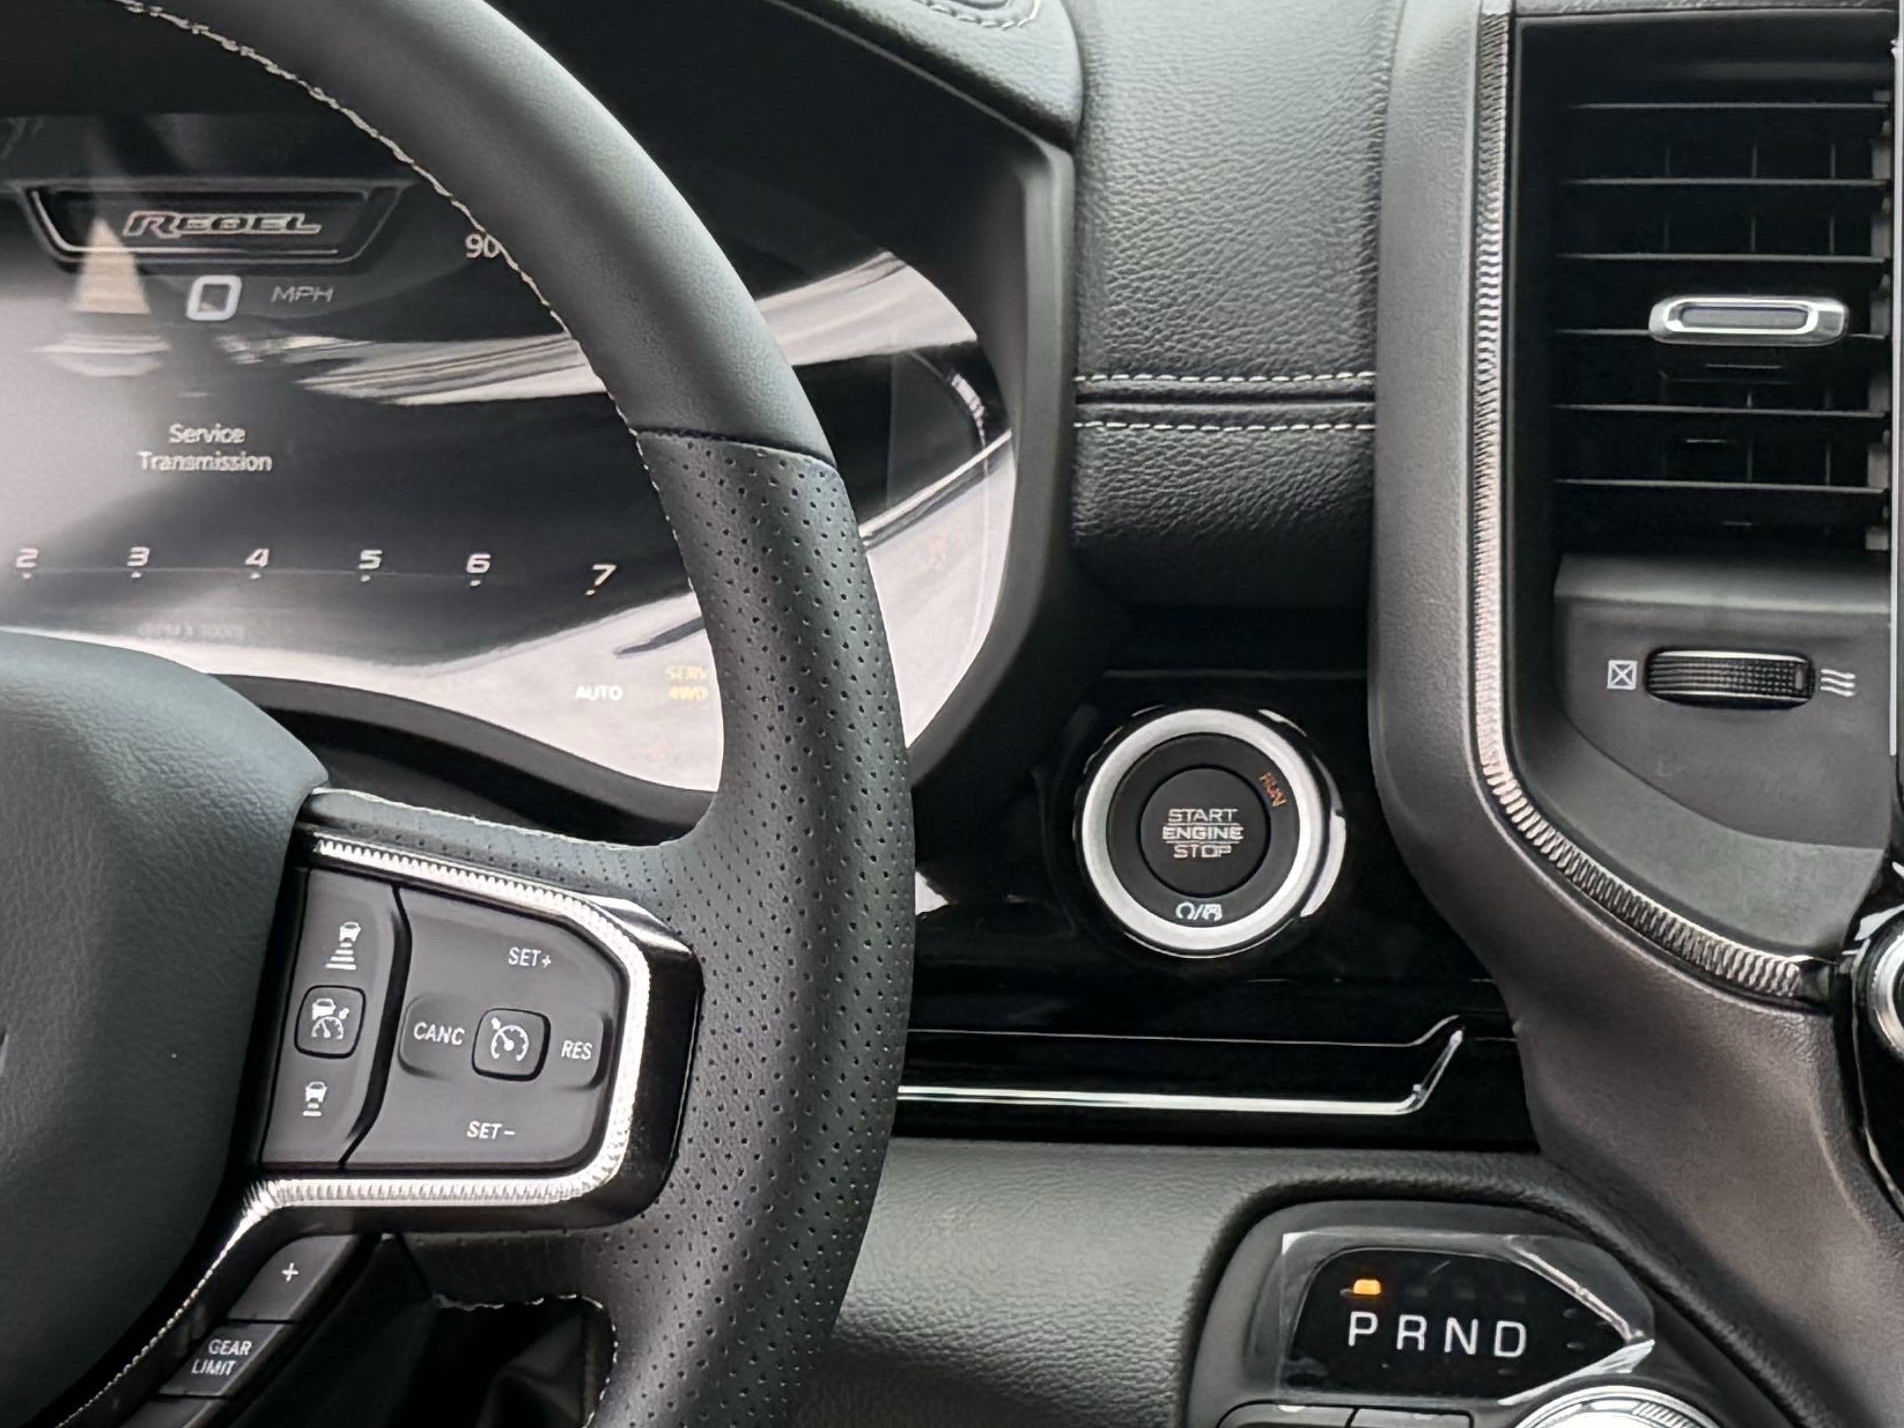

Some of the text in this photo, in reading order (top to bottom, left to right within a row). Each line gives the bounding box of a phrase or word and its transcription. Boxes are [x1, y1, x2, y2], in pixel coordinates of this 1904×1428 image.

[123, 211, 322, 238] REBEL
[465, 234, 498, 258] 90
[186, 275, 334, 321] 0 MPH
[169, 423, 245, 443] Service
[138, 451, 272, 472] Transmission
[16, 549, 38, 569] 2
[127, 548, 149, 568] 3
[246, 549, 270, 568] 4
[360, 550, 382, 570] 5
[467, 554, 490, 574] 6
[593, 565, 615, 586] 7
[575, 684, 623, 701] AUTO
[1168, 808, 1238, 822] START
[1162, 826, 1244, 840] ENGINE
[1173, 844, 1232, 859] STOP
[413, 1022, 465, 1046] CANC
[562, 1041, 592, 1061] RES
[208, 1339, 252, 1356] GEAR
[192, 1359, 236, 1375] LIMIT
